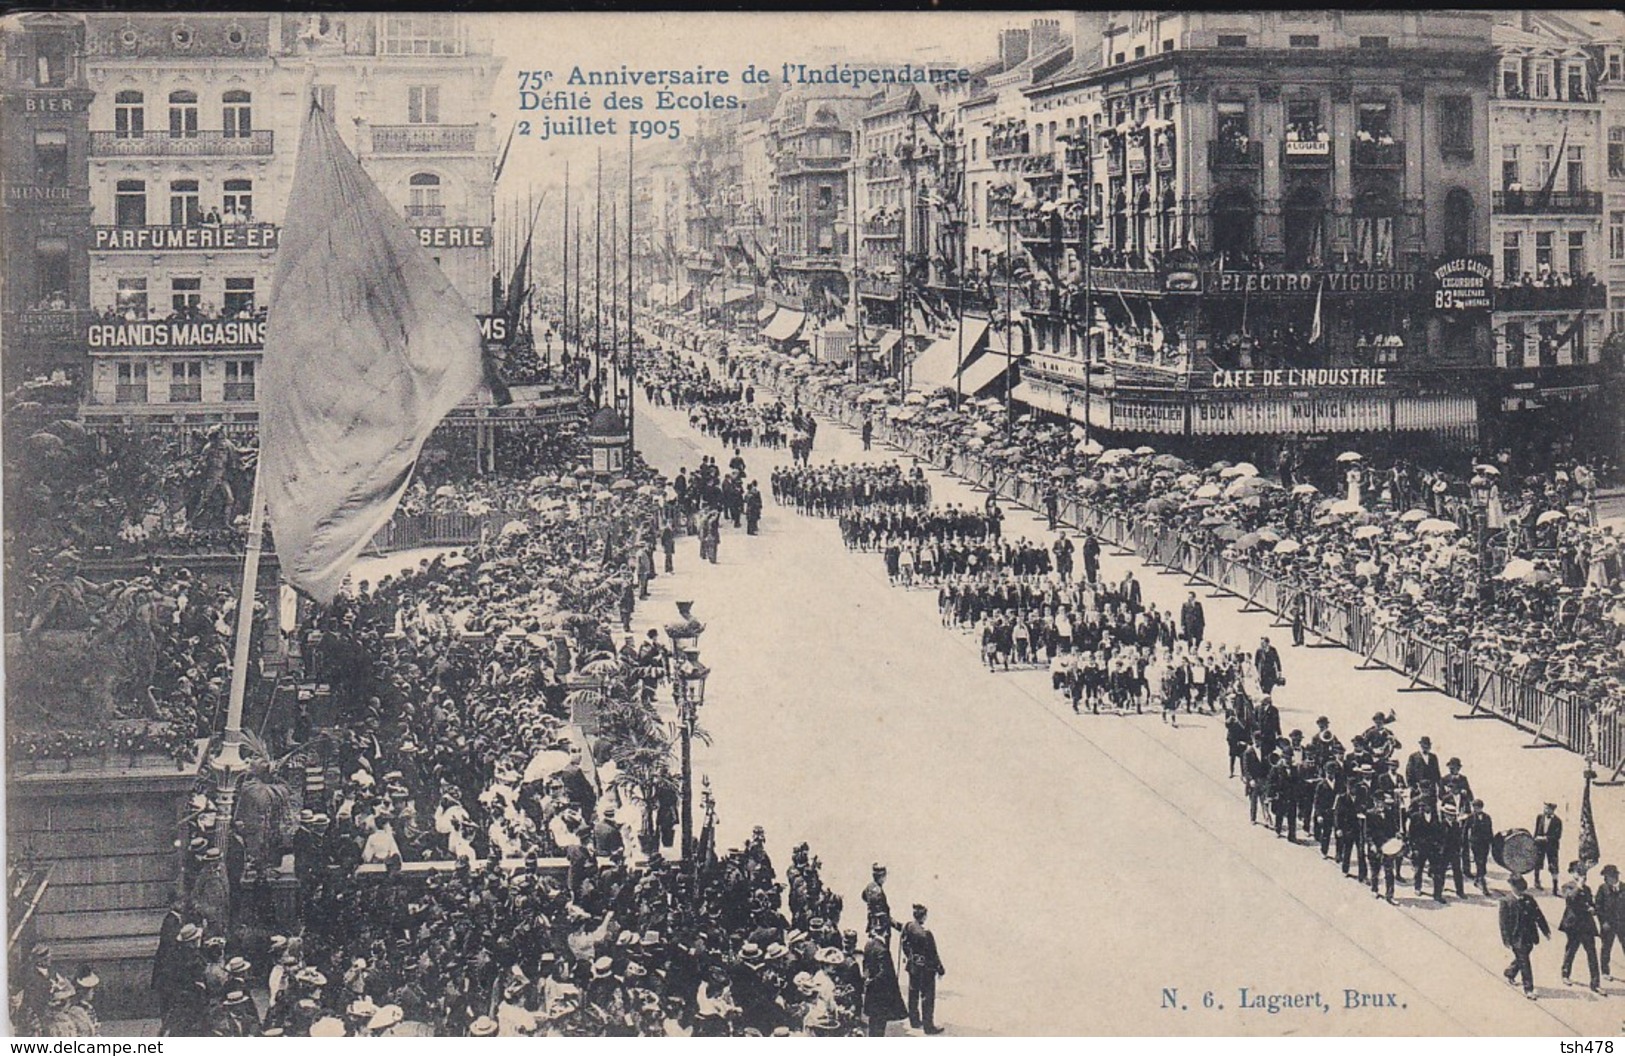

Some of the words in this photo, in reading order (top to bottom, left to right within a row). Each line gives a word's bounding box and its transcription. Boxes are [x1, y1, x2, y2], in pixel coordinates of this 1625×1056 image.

[26, 99, 73, 111] BIER
[10, 187, 71, 199] MUNICH
[96, 229, 281, 248] PARFUMERIE-EP
[411, 228, 484, 246] SERIE
[1221, 274, 1311, 291] ELECTRO
[1328, 274, 1415, 291] VIGUEUR
[1435, 290, 1453, 309] 83
[88, 325, 168, 346] GRANDS
[1212, 370, 1255, 389] CAFE
[1263, 370, 1283, 386] DE
[1288, 368, 1387, 386] L'INDUSTRIE
[1201, 406, 1235, 420] BOCK
[1292, 405, 1347, 419] MUNICH
